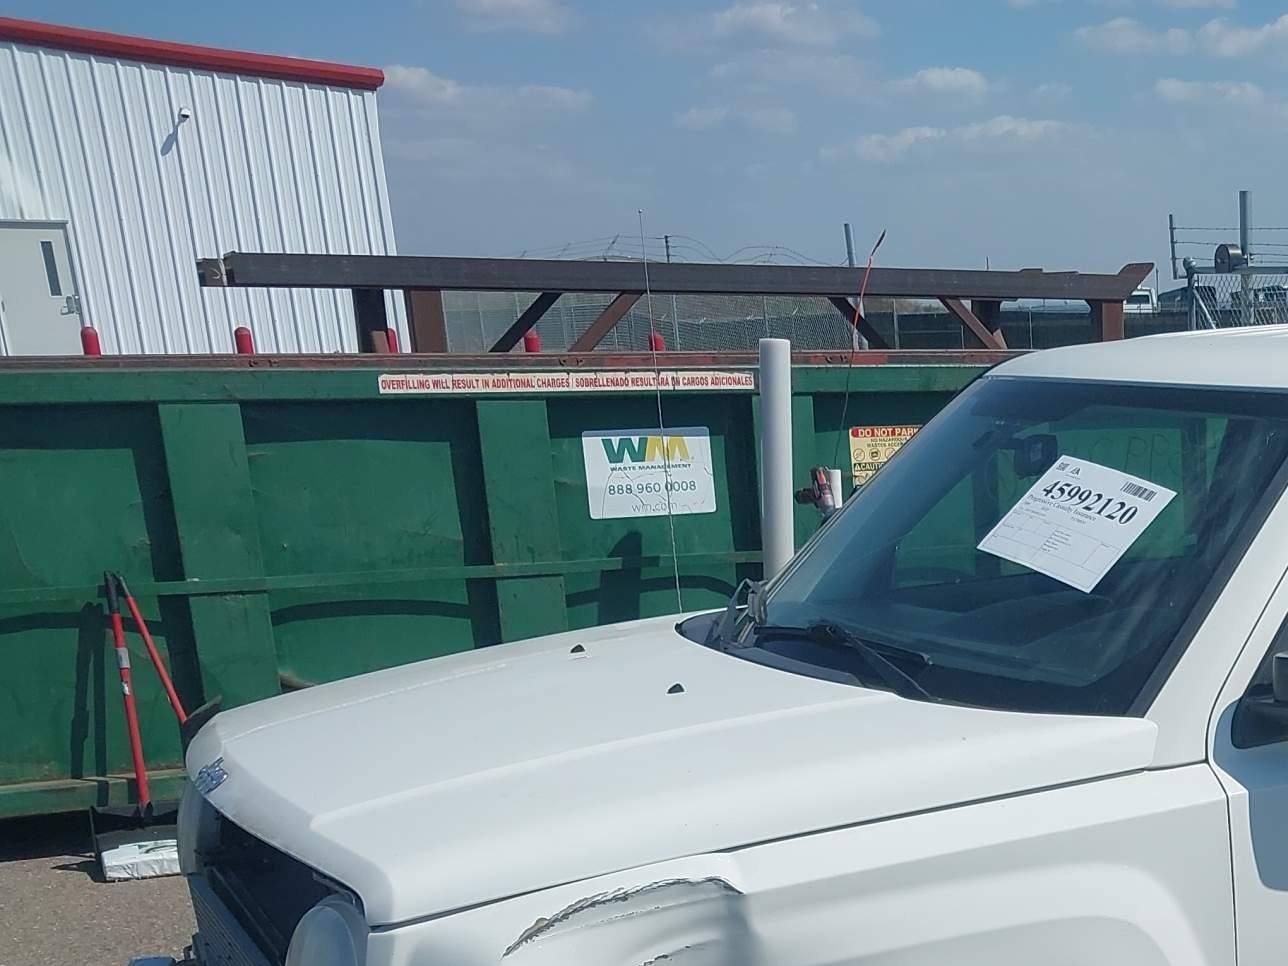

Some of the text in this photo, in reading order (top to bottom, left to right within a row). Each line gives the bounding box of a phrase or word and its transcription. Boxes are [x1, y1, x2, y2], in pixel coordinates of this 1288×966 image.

[381, 379, 430, 390] OVERFILLING
[432, 379, 450, 390] WILL
[452, 378, 479, 389] RESULT
[482, 379, 490, 388] IN
[491, 378, 535, 388] ADDITIONAL
[537, 377, 570, 388] CHARGES
[575, 376, 629, 388] SOBRELLENADO
[682, 375, 709, 386] CARGOS
[711, 376, 753, 386] ADICIONALES
[858, 429, 872, 438] DO
[874, 428, 894, 437] NOT
[601, 434, 690, 463] WM
[639, 463, 692, 472] MANAGEMENT
[608, 480, 697, 495] 888 960 0008
[1041, 480, 1139, 525] 45992120
